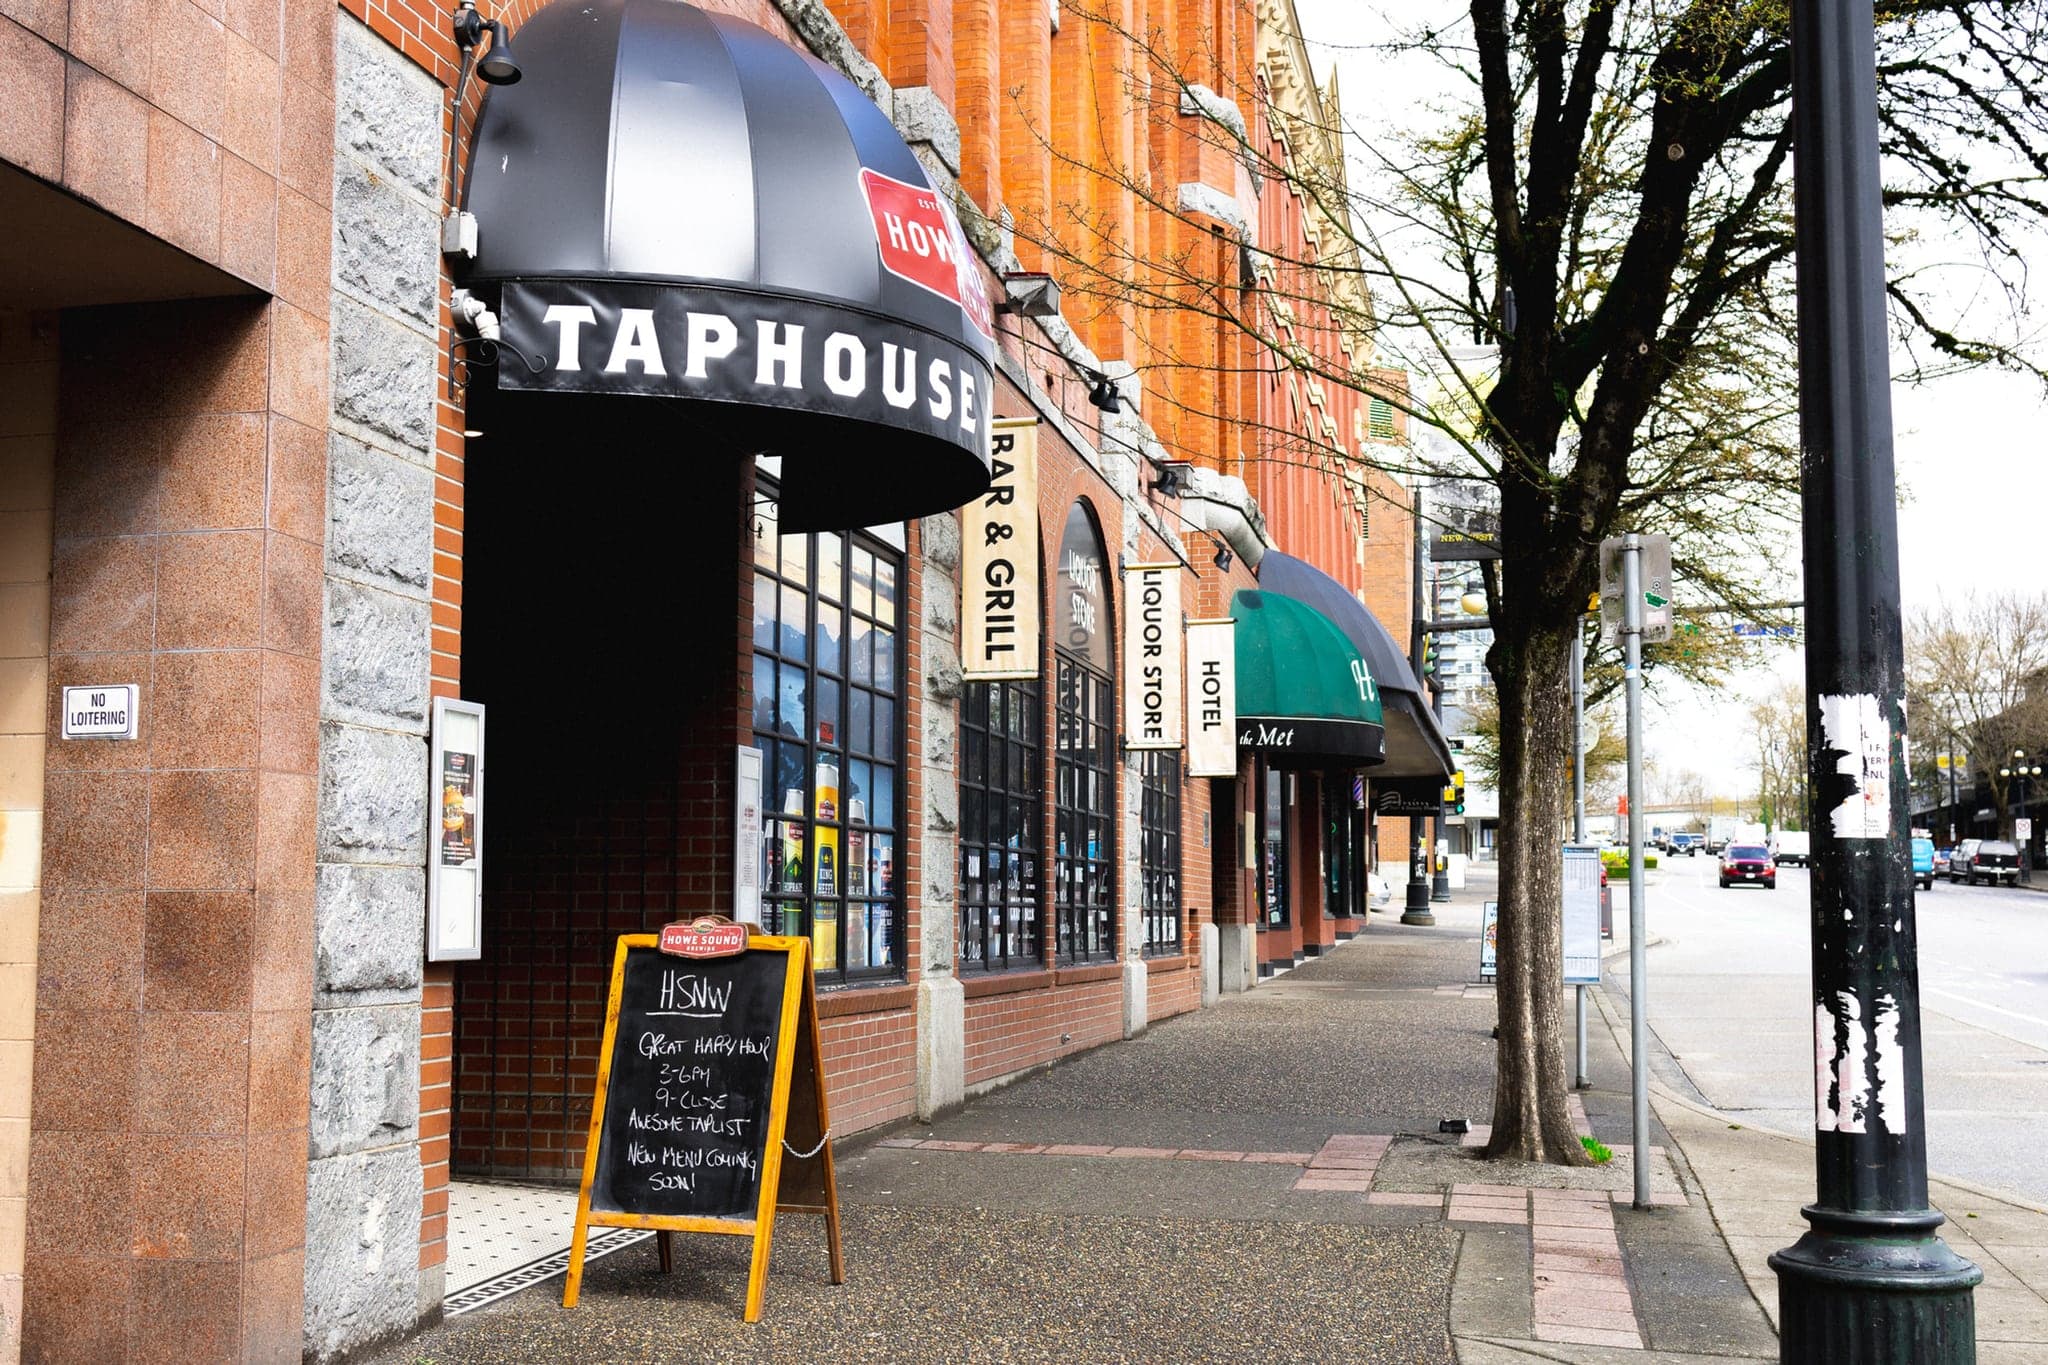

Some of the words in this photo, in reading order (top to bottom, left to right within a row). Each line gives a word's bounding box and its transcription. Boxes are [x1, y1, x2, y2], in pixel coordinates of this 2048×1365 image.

[884, 210, 958, 265] HOW
[542, 304, 977, 434] TAPHOUSE
[985, 433, 1014, 508] BAR
[985, 521, 1014, 547] &
[1440, 533, 1464, 543] NEW
[1465, 532, 1494, 542] EST
[1068, 549, 1097, 597] LIQUOR
[985, 558, 1015, 661] GRILL
[1072, 592, 1096, 634] STORE
[1143, 570, 1162, 658] LIQUOR
[91, 693, 106, 707] NO
[1143, 666, 1163, 739] STORE
[1202, 660, 1221, 731] HOTEL
[71, 710, 126, 726] LOITERING
[1239, 730, 1253, 745] the
[1256, 723, 1294, 746] Met
[667, 935, 698, 945] HOWE
[701, 935, 738, 945] SOUND
[660, 969, 732, 1012] HSNW
[639, 1032, 688, 1060] GREAT
[694, 1034, 738, 1056] HAPPY
[740, 1036, 771, 1062] HOUR
[629, 1107, 683, 1132] AWESOME
[627, 1141, 656, 1166] NEW
[662, 1147, 702, 1168] MENU
[706, 1148, 757, 1182] COMING
